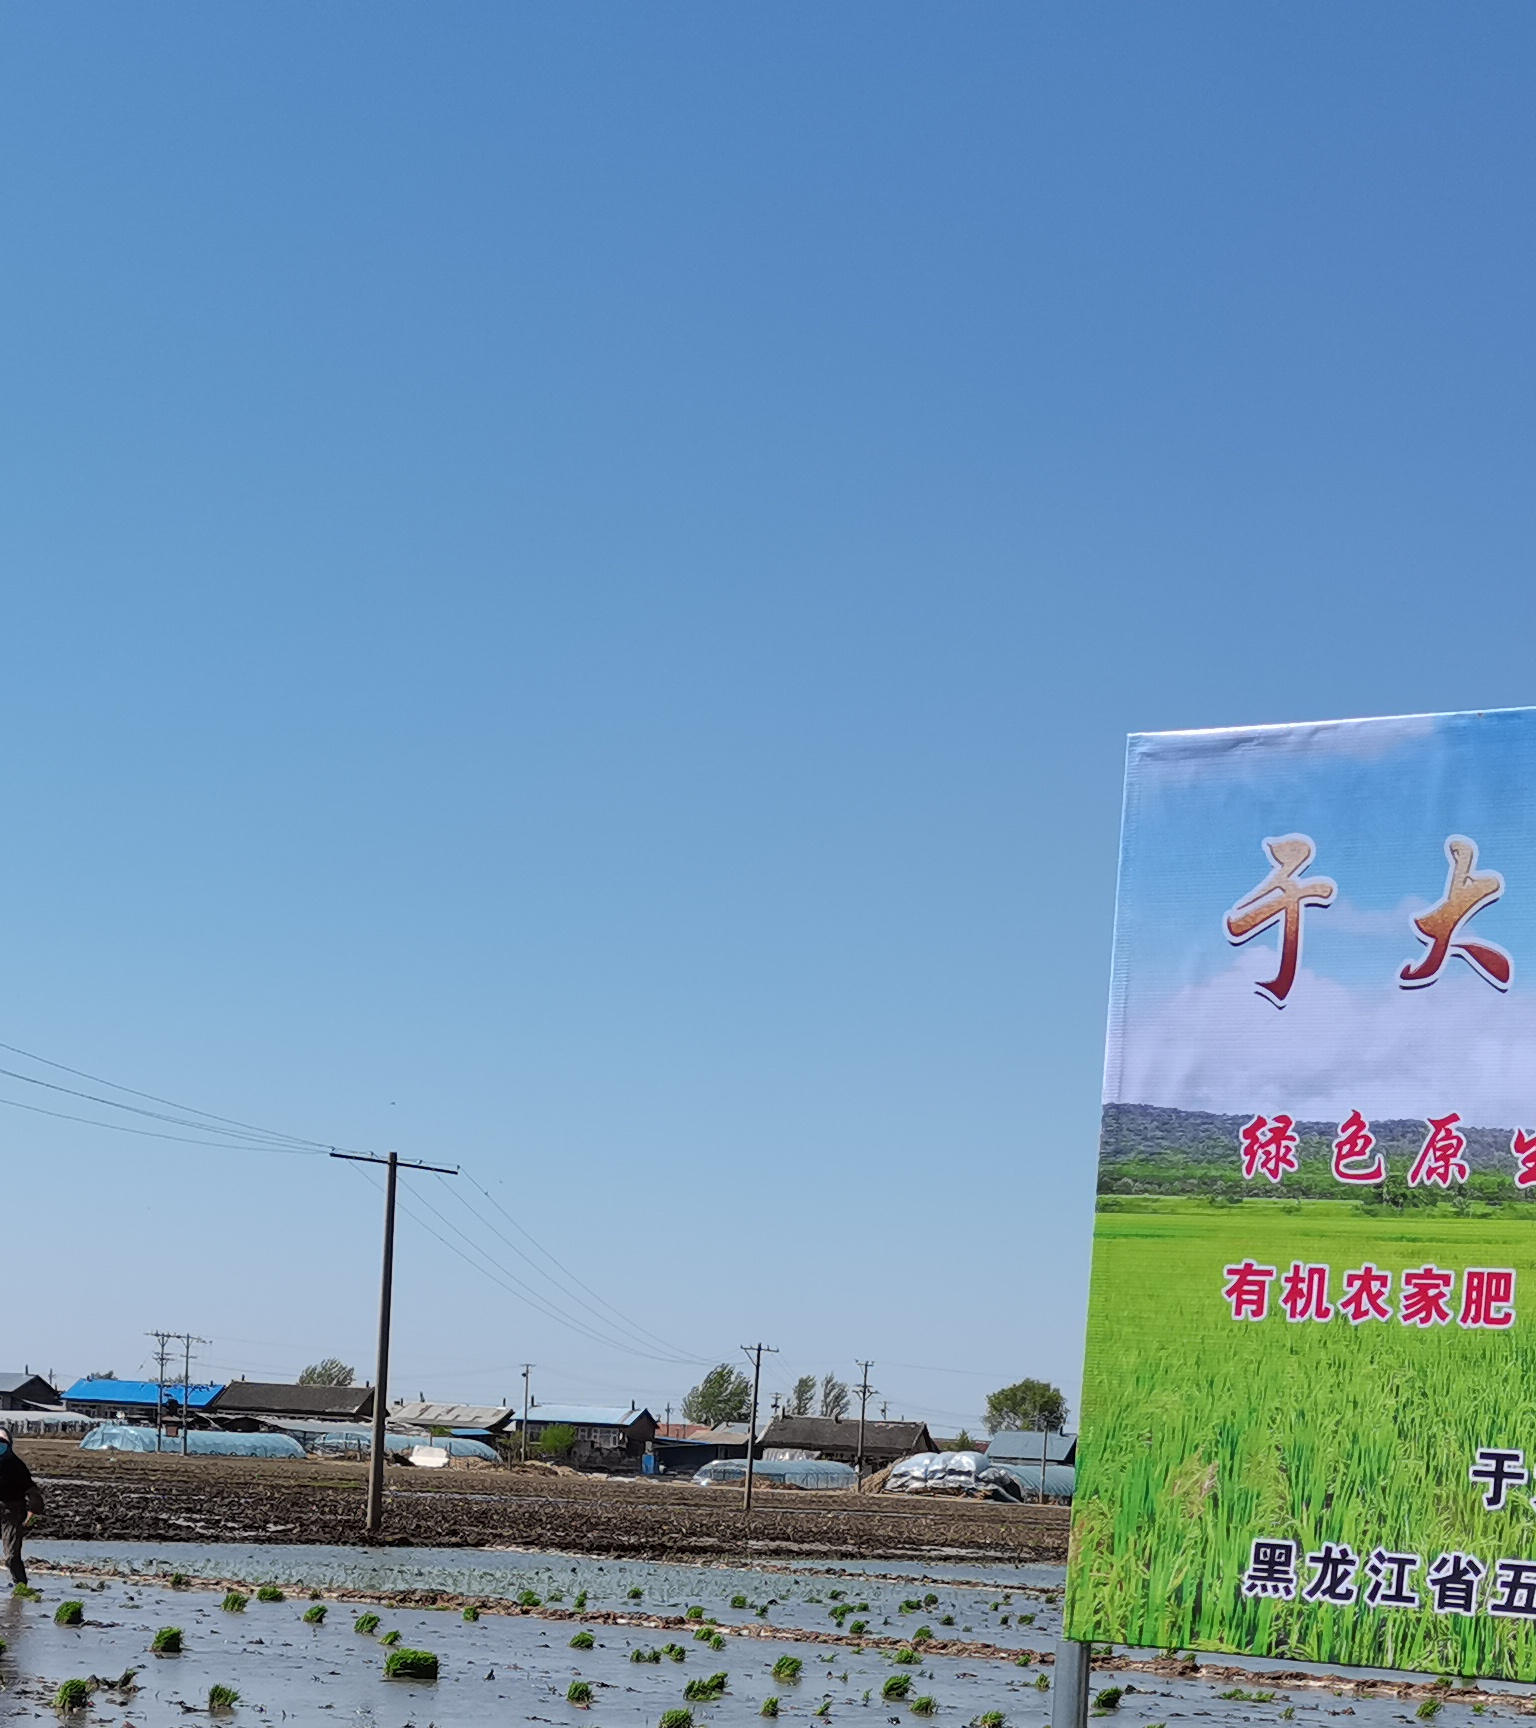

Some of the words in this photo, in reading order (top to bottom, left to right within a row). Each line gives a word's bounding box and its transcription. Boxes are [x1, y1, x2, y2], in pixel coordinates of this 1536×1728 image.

[1224, 1263, 1516, 1328] 有机农家肥
